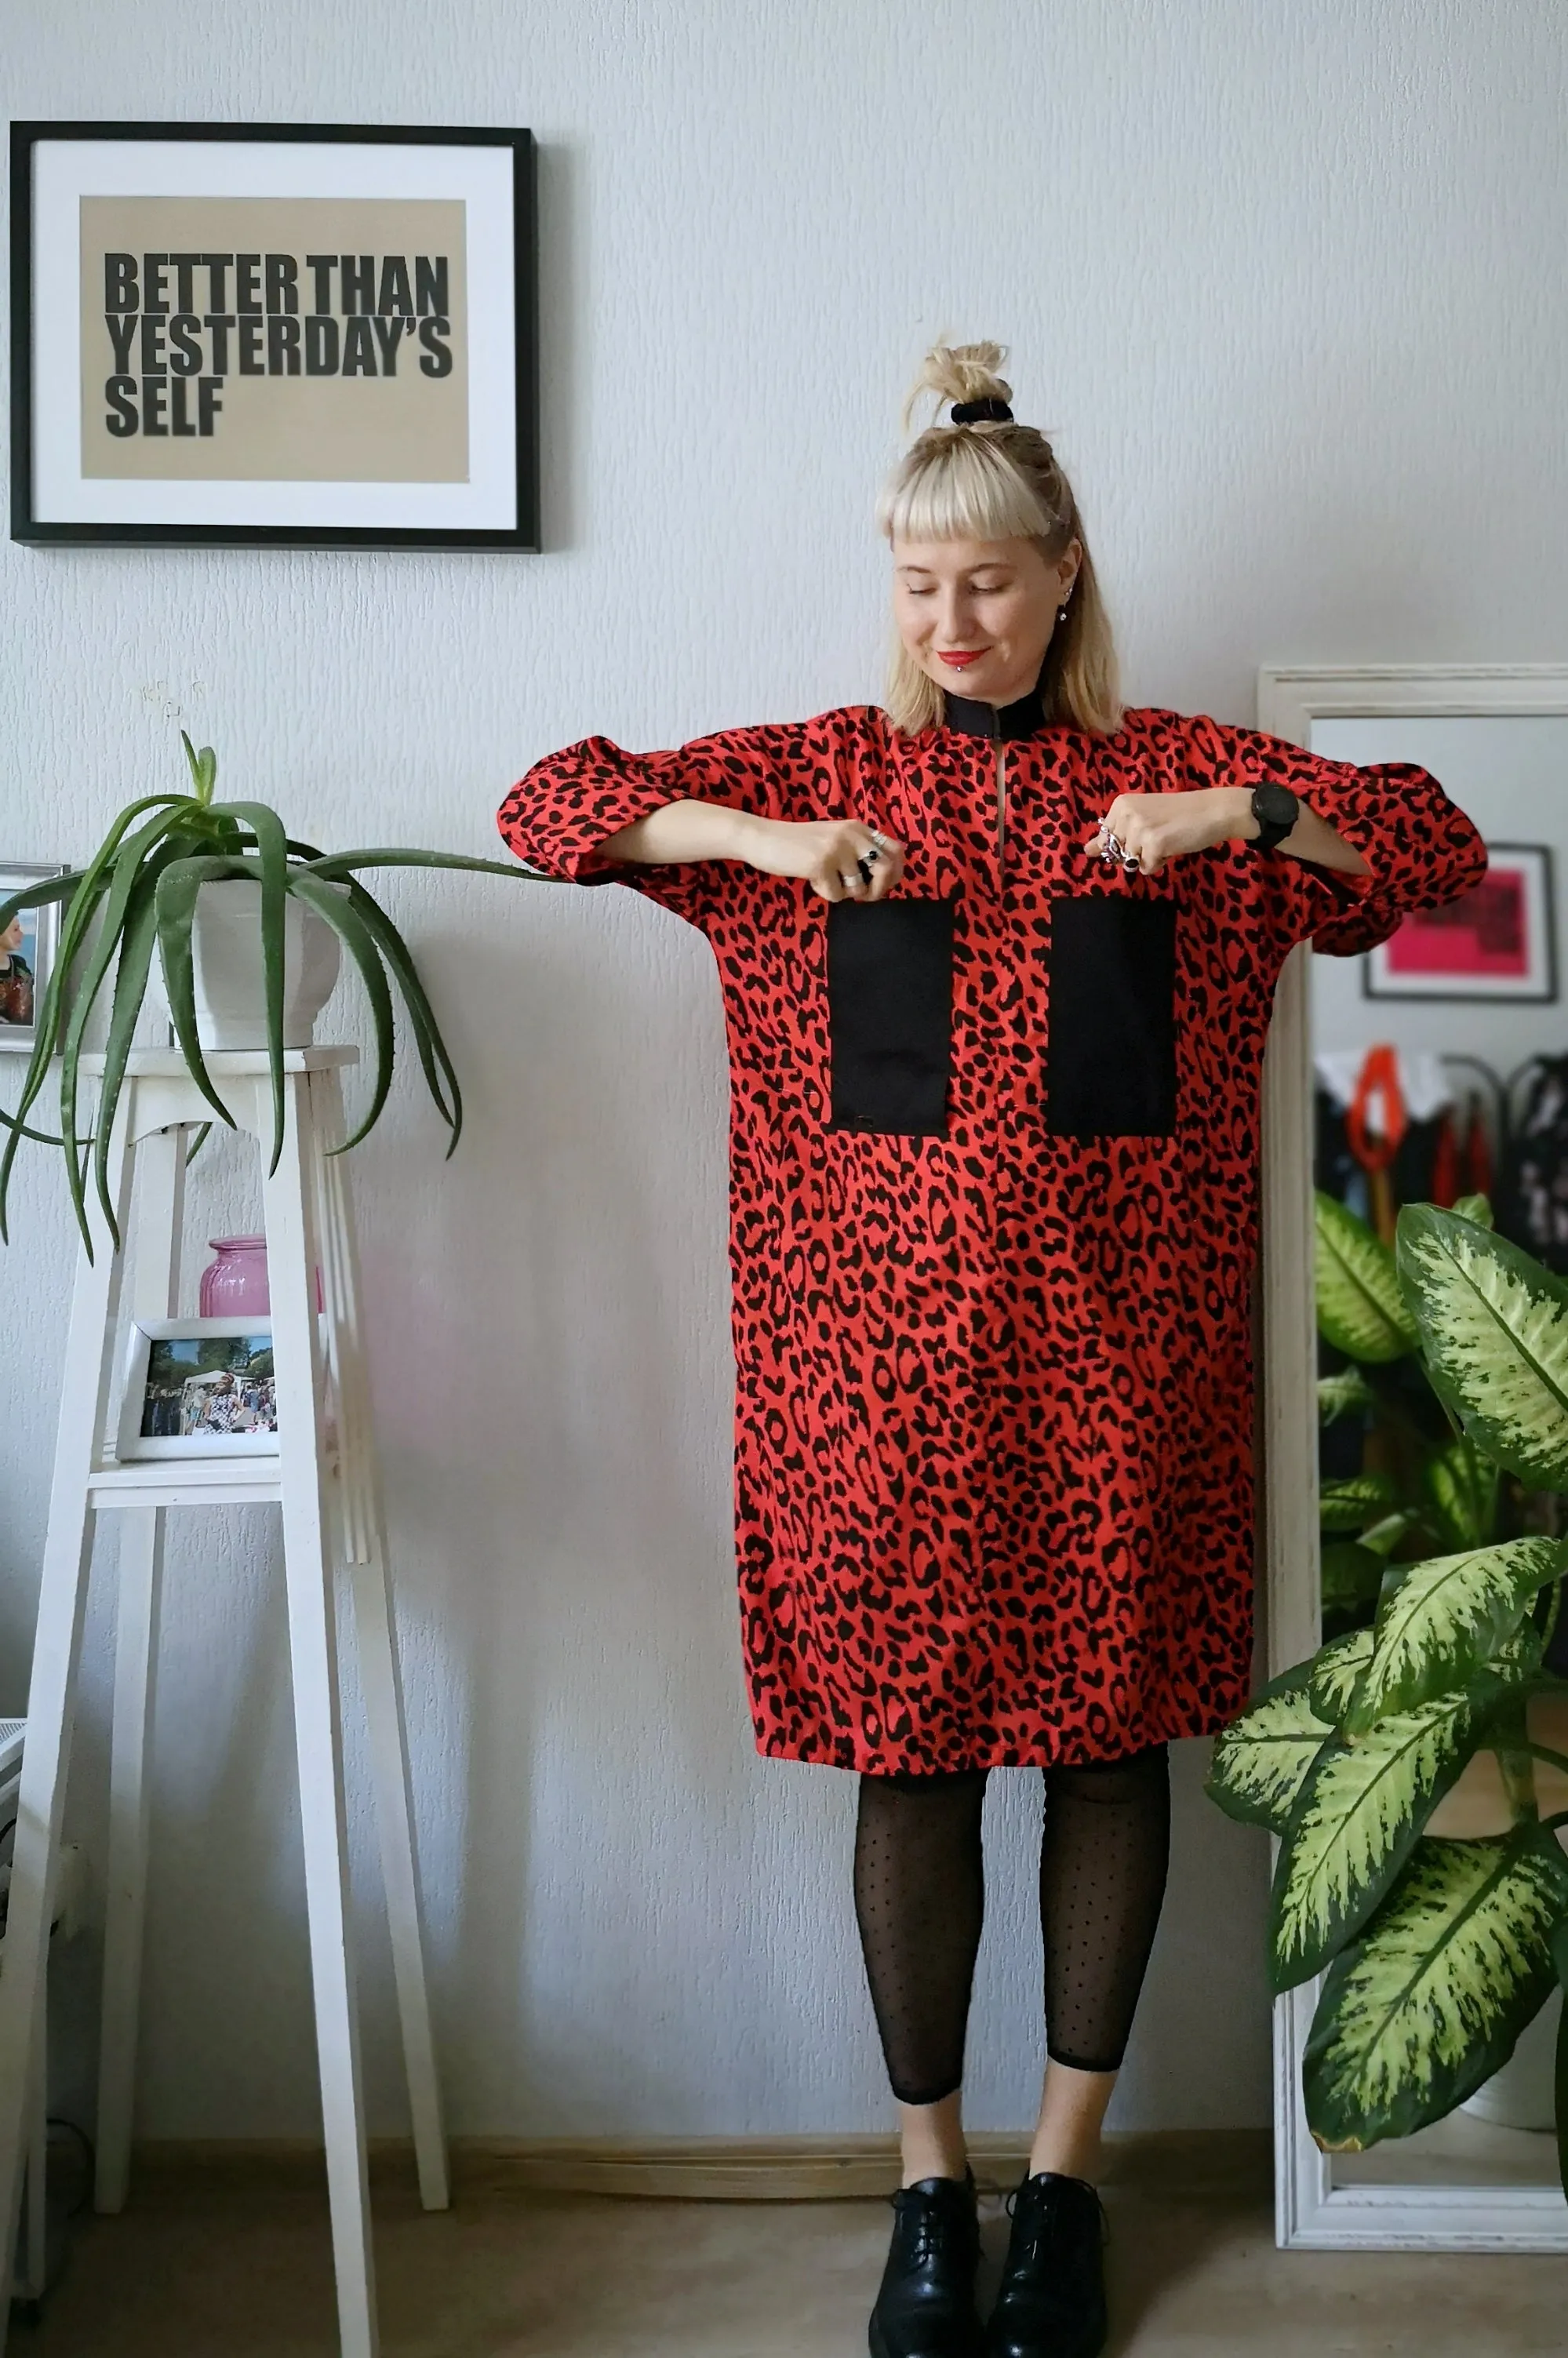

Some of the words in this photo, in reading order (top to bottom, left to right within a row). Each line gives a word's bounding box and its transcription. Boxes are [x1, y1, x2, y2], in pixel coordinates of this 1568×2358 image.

[104, 253, 299, 315] BETTER
[306, 255, 449, 317] THAN
[105, 314, 453, 378] YESTERDAY’S
[105, 375, 224, 438] SELF
